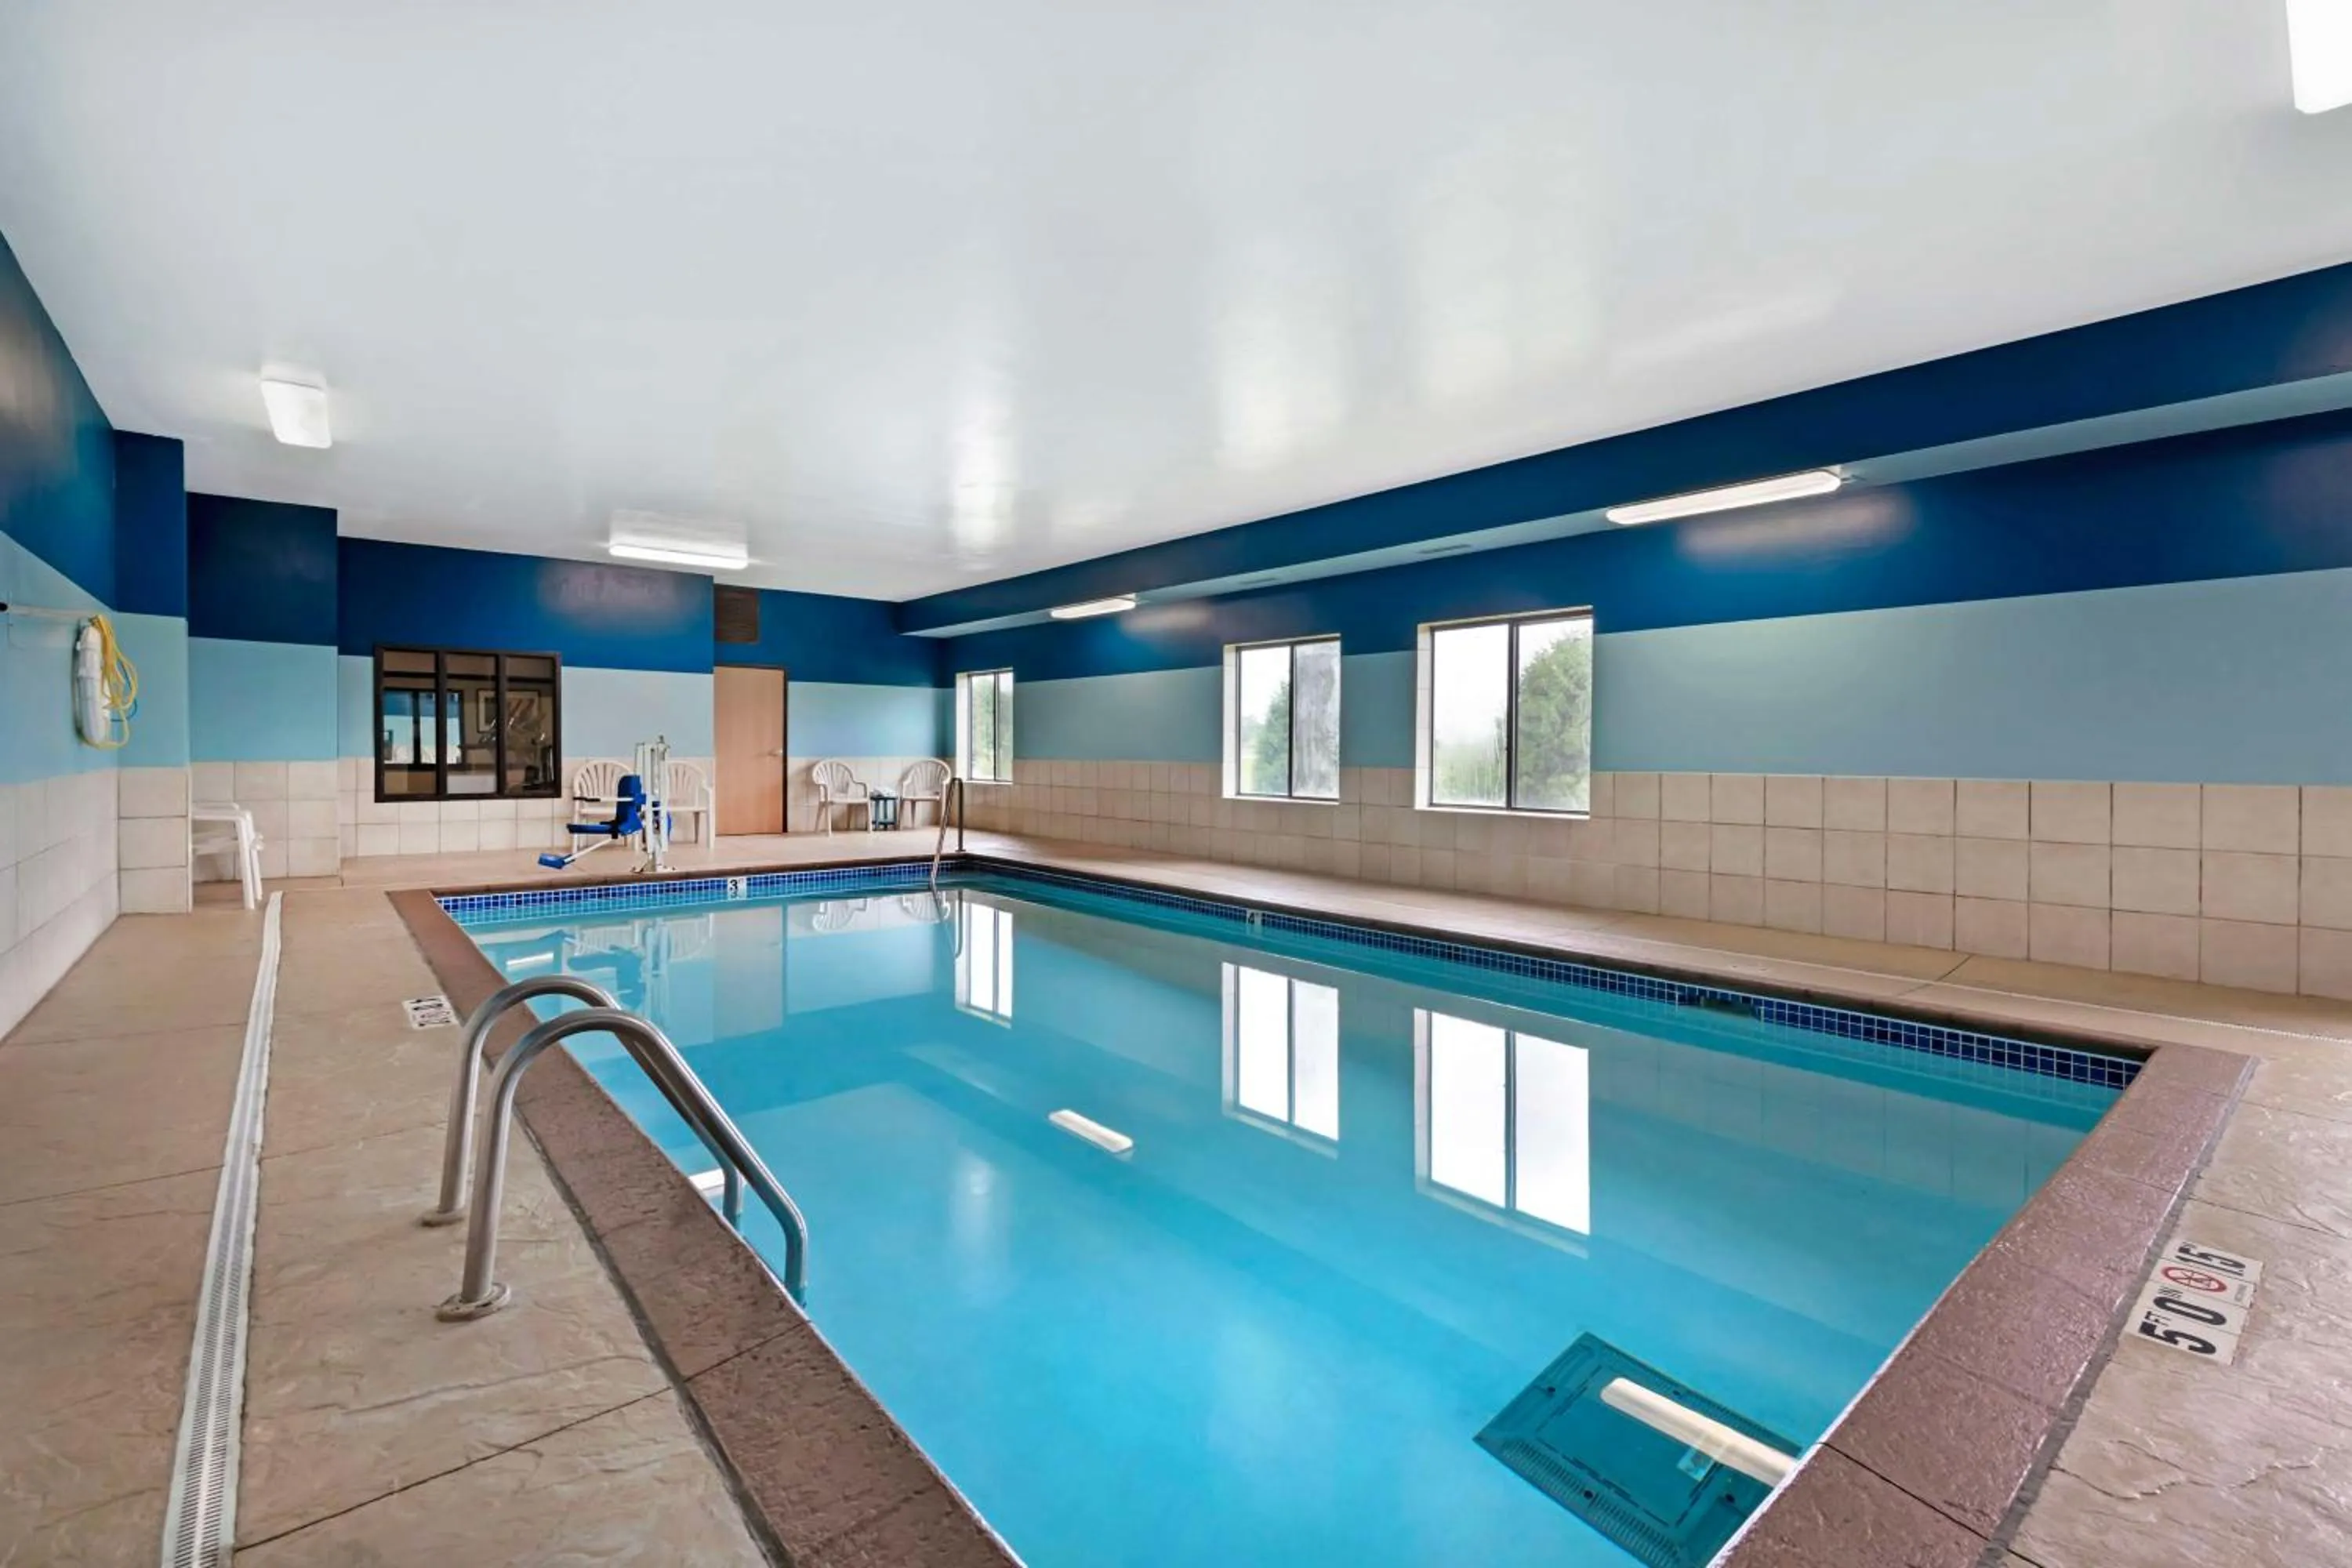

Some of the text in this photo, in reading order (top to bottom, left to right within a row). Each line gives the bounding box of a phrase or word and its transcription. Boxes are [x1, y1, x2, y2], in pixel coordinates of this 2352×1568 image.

[730, 879, 738, 891] 3
[2153, 1297, 2227, 1325] 0
[2139, 1321, 2216, 1354] 5
